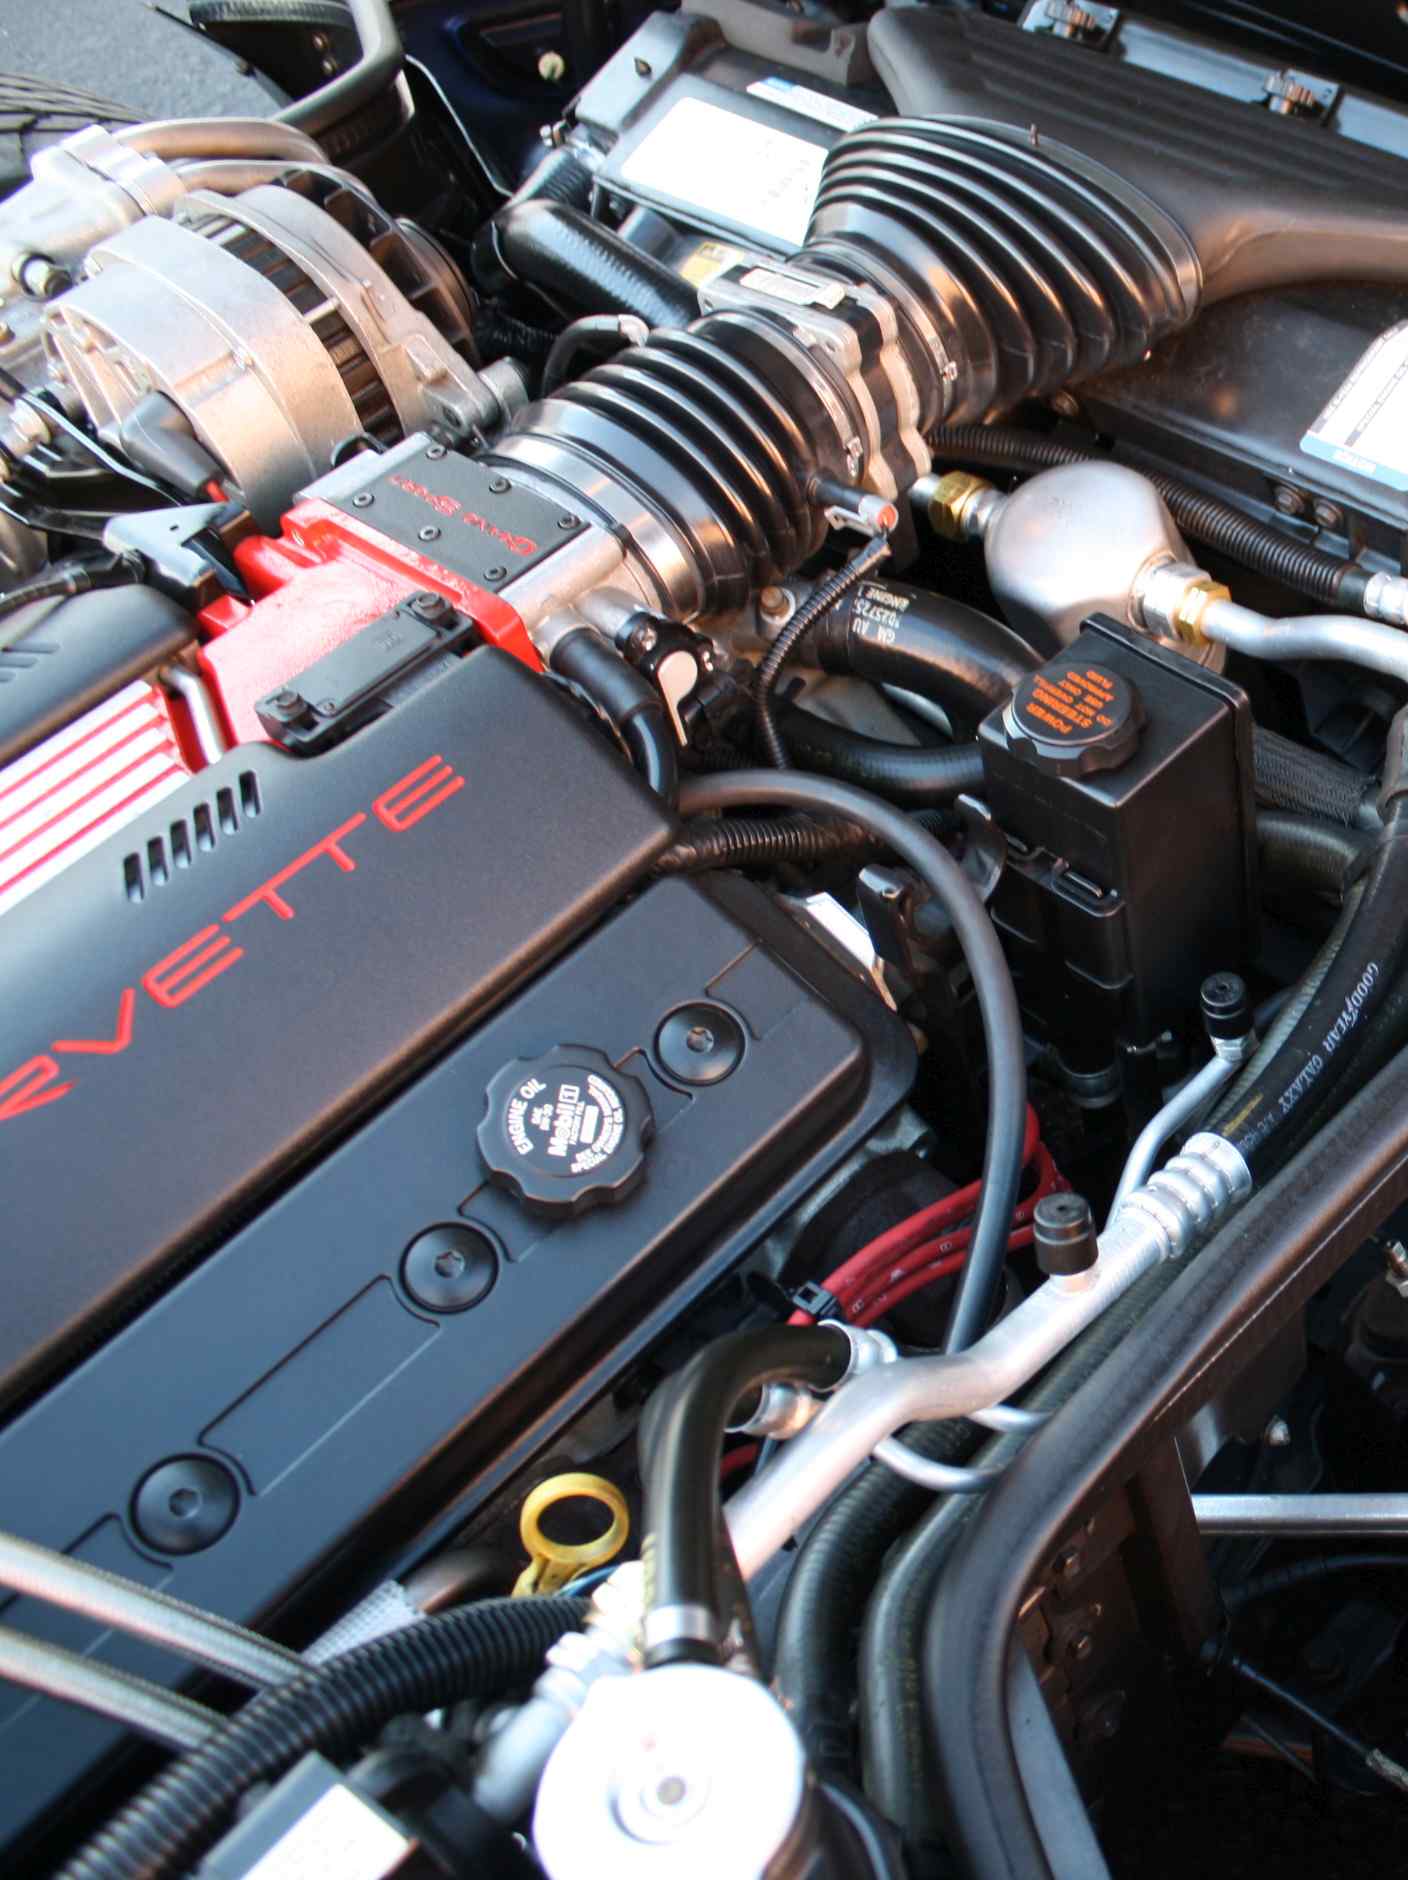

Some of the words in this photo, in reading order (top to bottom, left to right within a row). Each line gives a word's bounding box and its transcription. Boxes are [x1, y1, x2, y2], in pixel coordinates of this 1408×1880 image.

[878, 625, 896, 645] GM
[1026, 703, 1072, 735] POWER
[1032, 687, 1093, 728] STEERING
[1323, 962, 1380, 1054] GOODYEAR
[520, 1078, 546, 1099] OIL
[1279, 1055, 1324, 1112] GALAXY
[508, 1098, 534, 1155] ENGINE
[548, 1102, 576, 1156] Mobil
